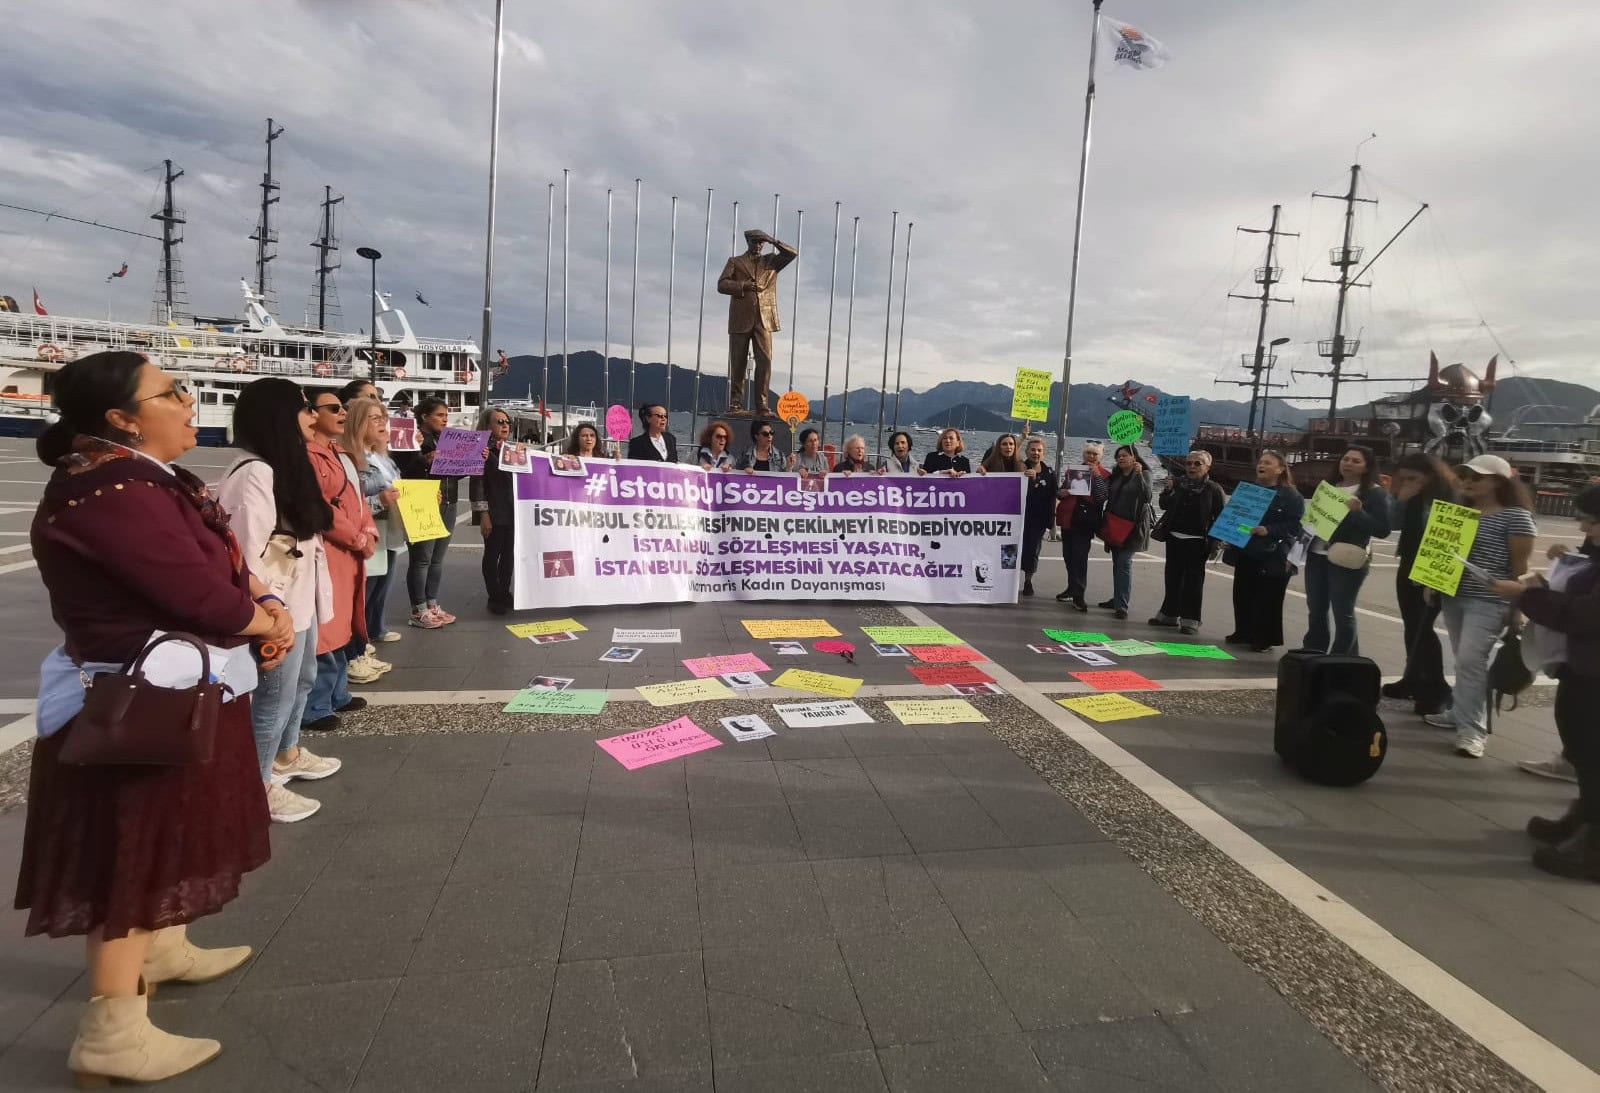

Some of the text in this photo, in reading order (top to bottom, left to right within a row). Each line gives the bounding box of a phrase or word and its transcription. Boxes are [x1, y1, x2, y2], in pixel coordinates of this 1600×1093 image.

[583, 468, 967, 512] #İstanbulSözleşmesiBizim
[534, 503, 629, 529] İSTANBUL
[783, 515, 874, 535] ÇEKİLMEYİ
[878, 517, 1012, 537] REDDEDİYORUZ!
[633, 534, 926, 560] İSTANBUL SÖZLEŞMESİ YAŞATIR,
[594, 557, 963, 579] İSTANBUL SÖZLEŞMESİNİ YAŞATACAĞIZ!
[741, 577, 786, 592] Kadın
[791, 578, 886, 594] Dayanışması
